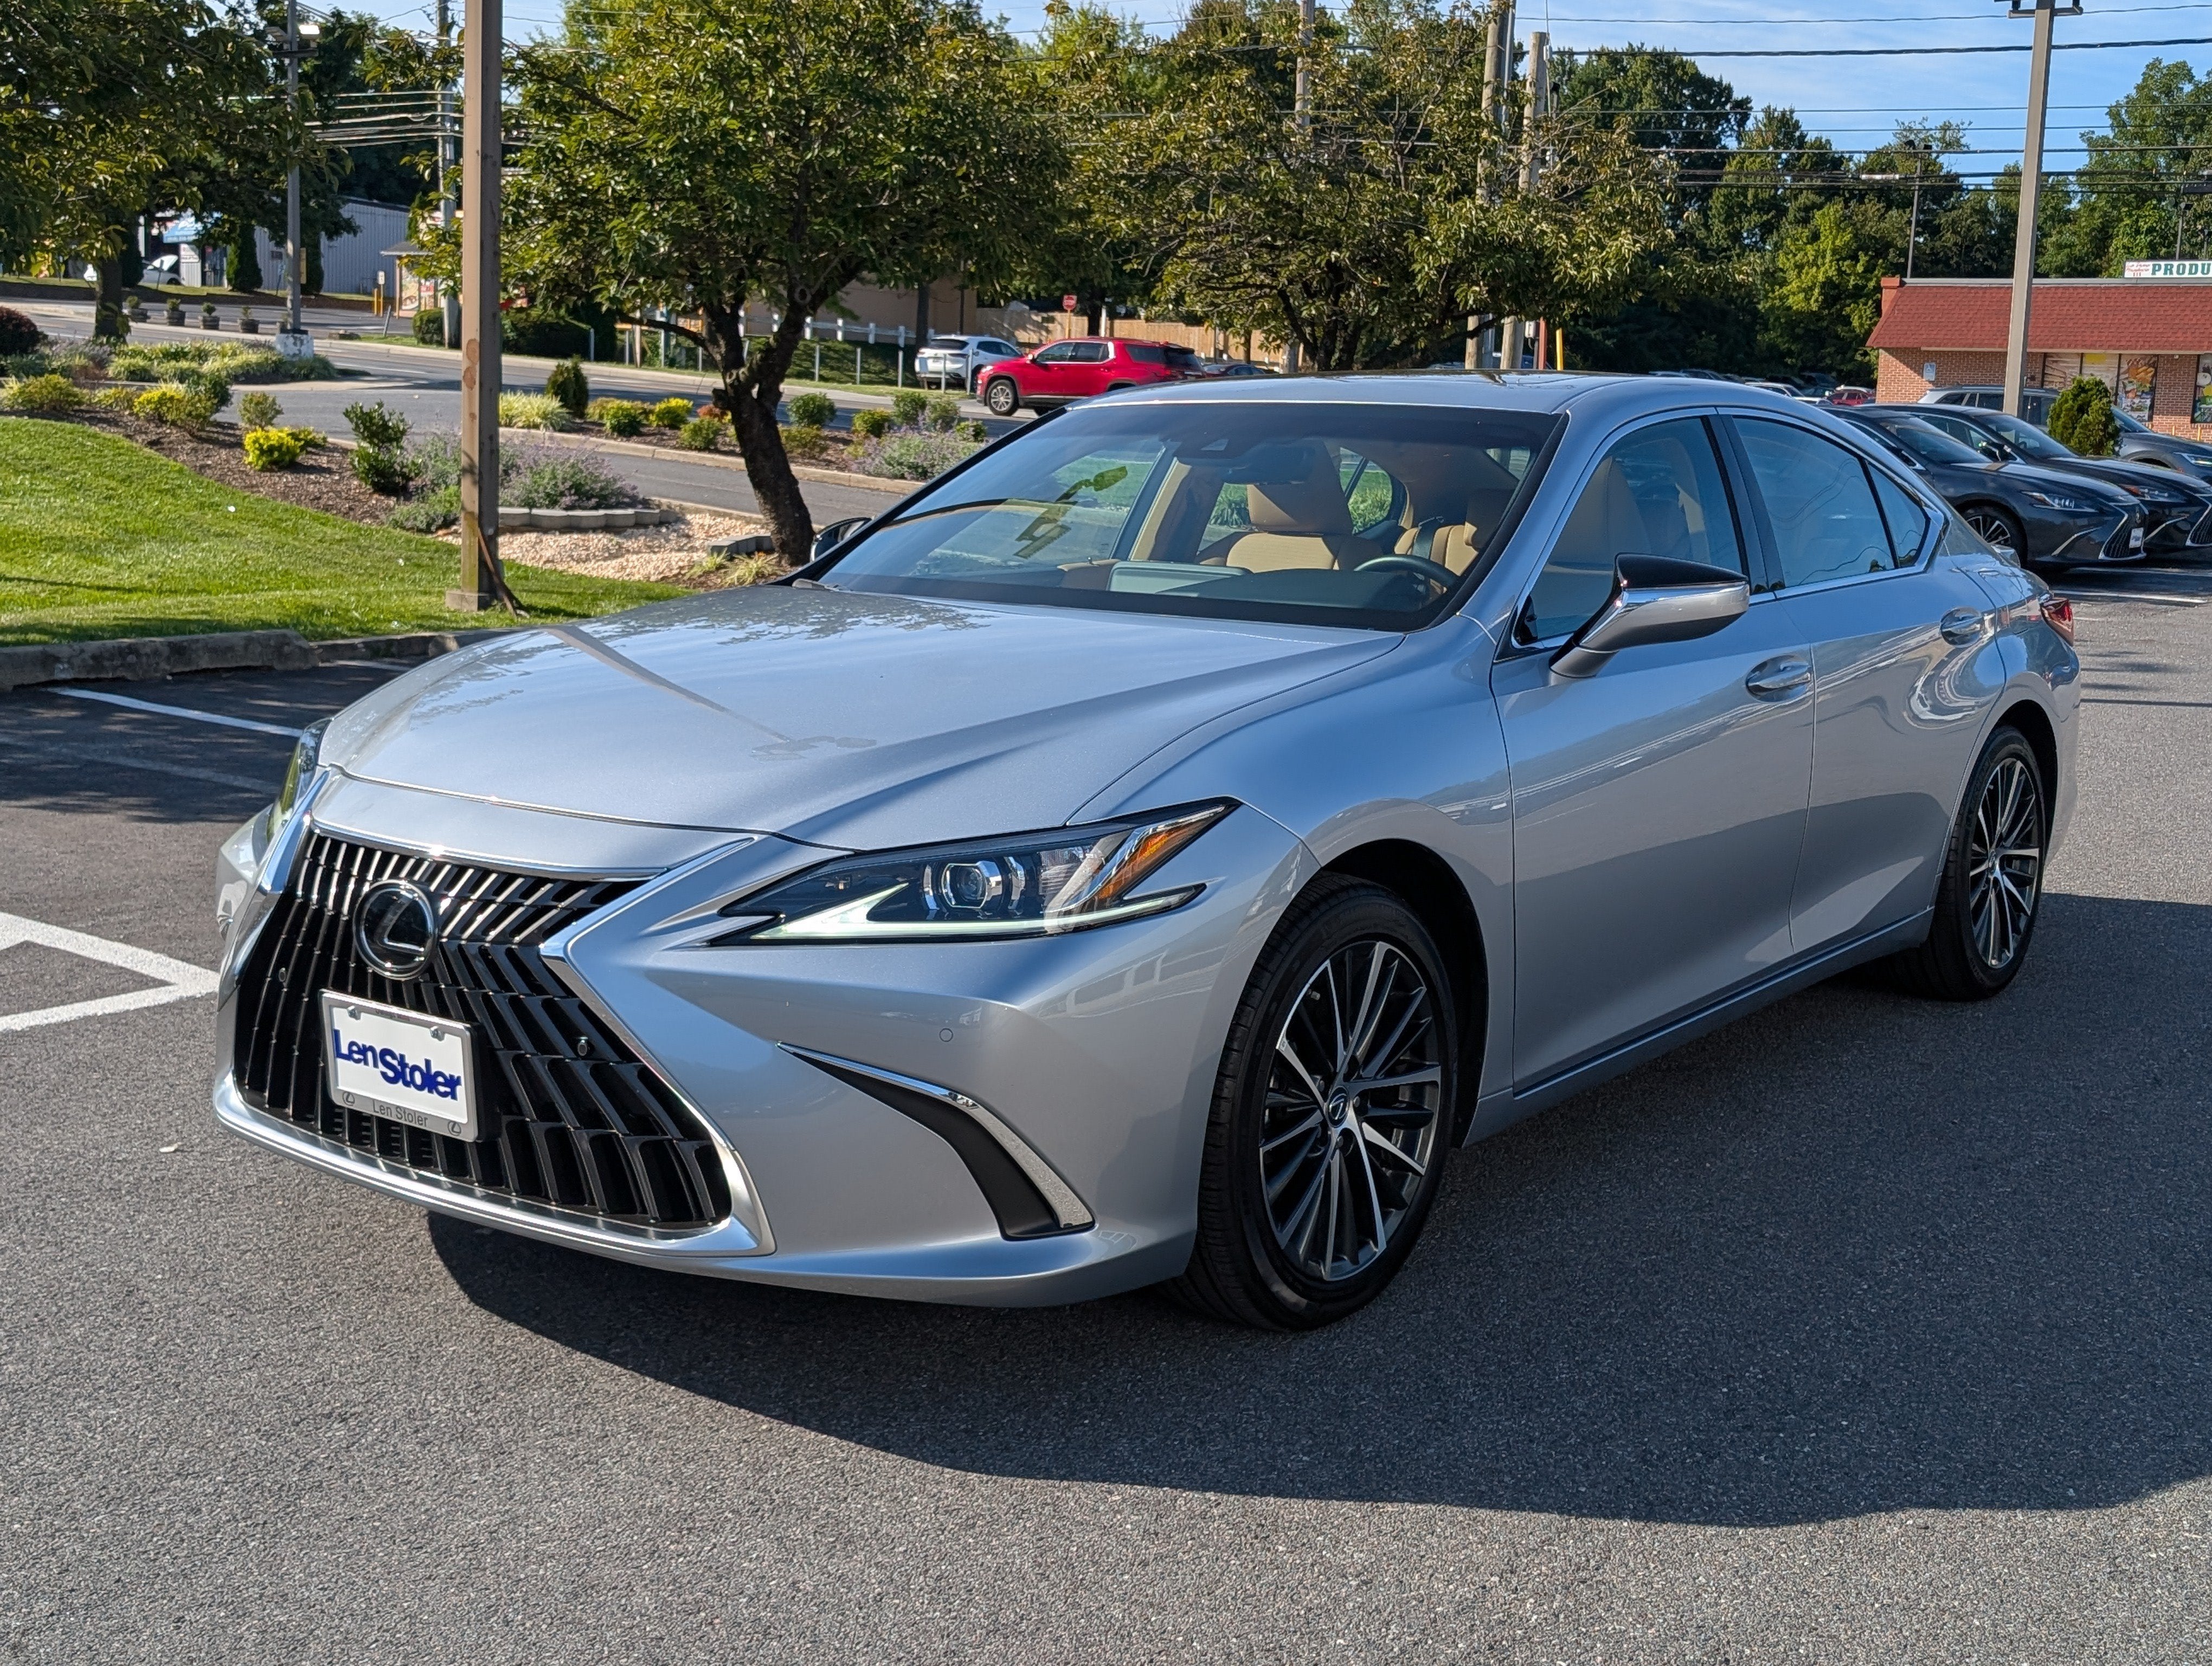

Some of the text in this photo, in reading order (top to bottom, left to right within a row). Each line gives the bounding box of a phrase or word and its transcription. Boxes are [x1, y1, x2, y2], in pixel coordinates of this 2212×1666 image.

[2151, 263, 2211, 275] PRODU
[372, 1100, 428, 1127] Len Stoler
